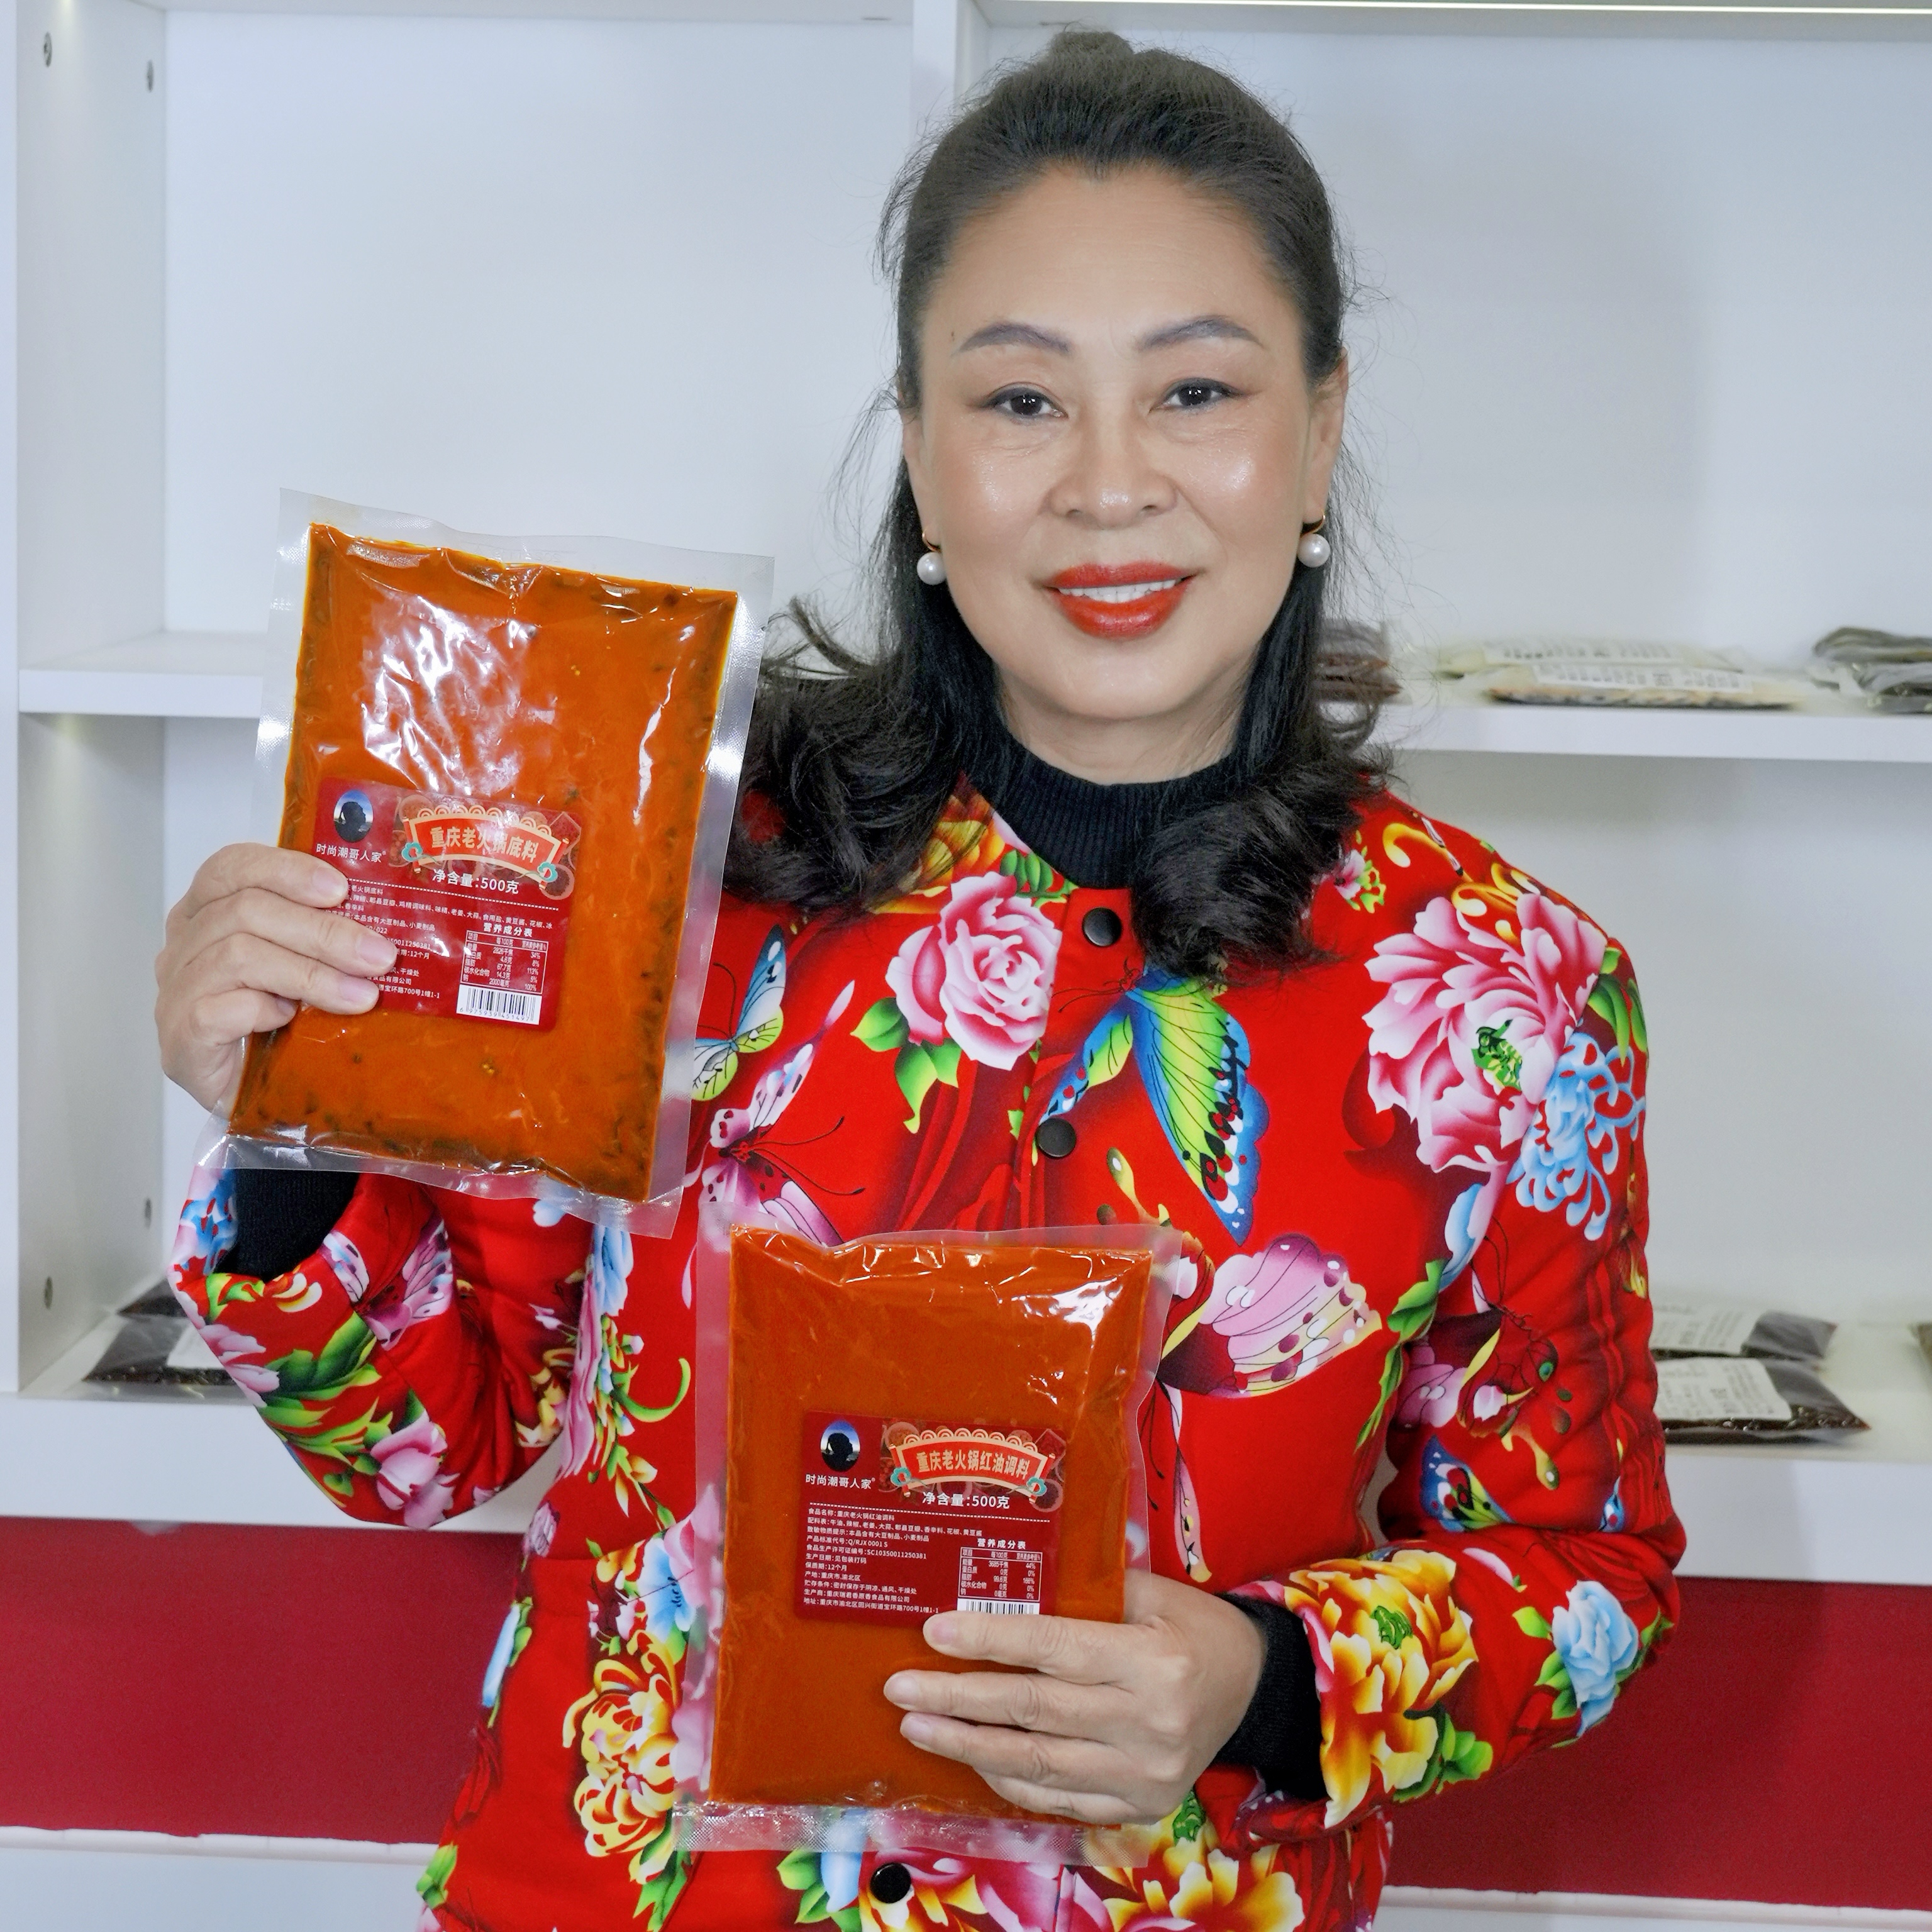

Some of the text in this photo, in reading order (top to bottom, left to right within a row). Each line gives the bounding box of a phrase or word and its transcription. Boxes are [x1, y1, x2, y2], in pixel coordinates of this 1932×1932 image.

[430, 826, 539, 863] 重庆老火锅底料
[316, 843, 382, 863] 时尚潮哥人家
[432, 869, 519, 894] 净含量:500克
[348, 884, 383, 895] 老火锅底料
[484, 923, 532, 937] 营养成分表
[397, 948, 430, 959] 期:12个月
[464, 967, 490, 977] 碳水化合物
[918, 1450, 1030, 1479] 重庆老火锅红油调料
[806, 1474, 871, 1489] 时尚潮哥人家
[923, 1492, 1009, 1509] 净含量:500克
[977, 1538, 1026, 1550] 营养成分表
[806, 1553, 867, 1564] 生产日期:见包装打码
[805, 1562, 847, 1571] 保质期:12个月
[961, 1581, 987, 1589] 碳水化合物
